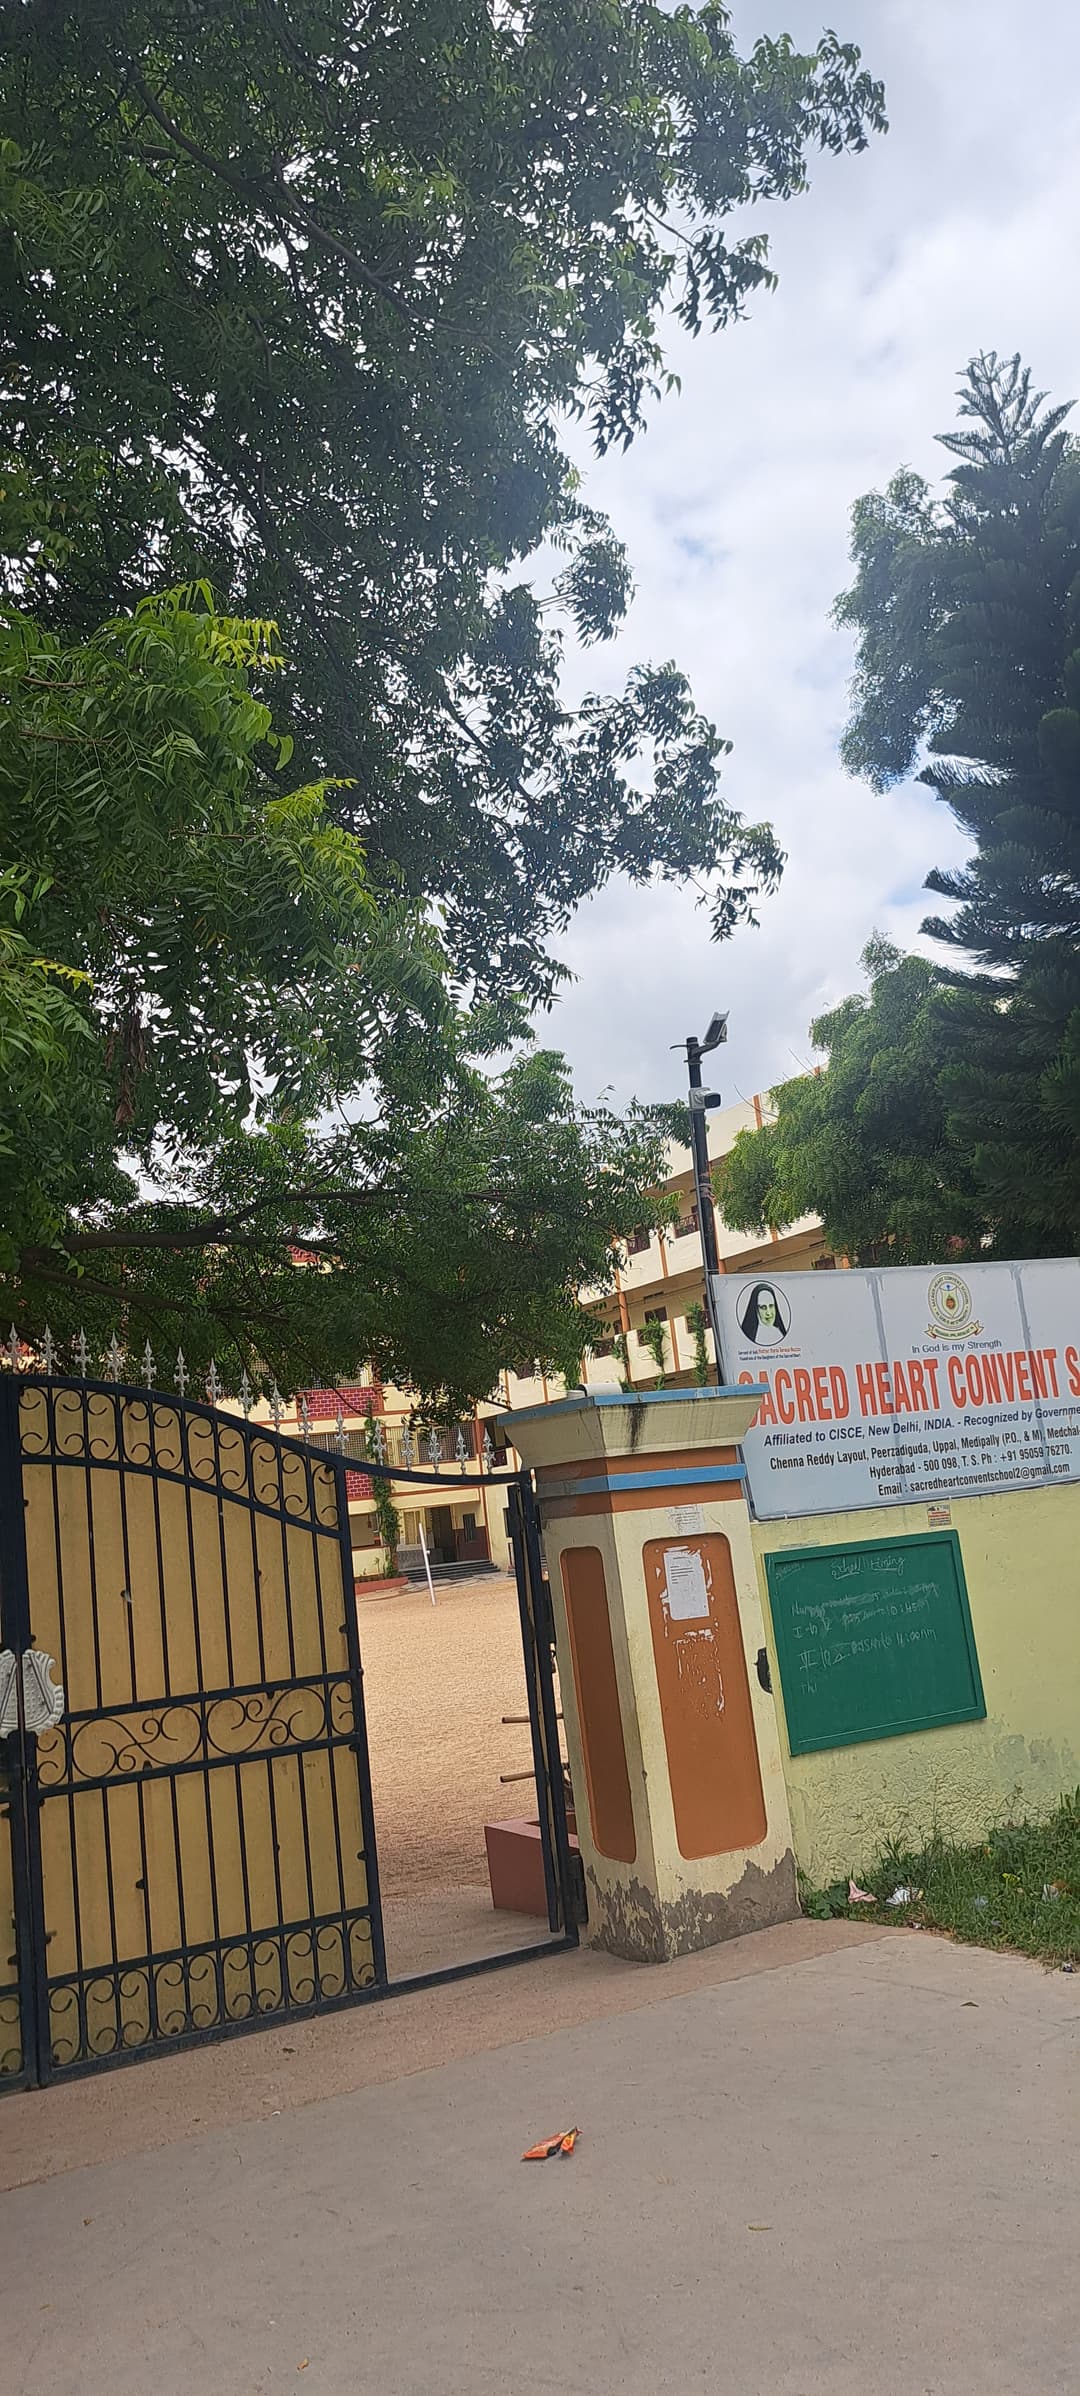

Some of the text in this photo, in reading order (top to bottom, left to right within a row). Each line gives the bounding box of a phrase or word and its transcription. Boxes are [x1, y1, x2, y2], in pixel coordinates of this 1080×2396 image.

[911, 1340, 1002, 1353] In God is my Strength
[855, 1358, 940, 1416] HEART
[948, 1349, 1059, 1408] CONVENT
[764, 1432, 812, 1447] Affiliated
[816, 1432, 826, 1442] to
[829, 1427, 865, 1440] CISCE,
[868, 1424, 890, 1436] New
[893, 1420, 921, 1434] Delhi,
[924, 1417, 955, 1430] INDIA.
[963, 1410, 1019, 1426] Recognized
[1021, 1410, 1033, 1422] by
[770, 1457, 804, 1470] Chenna
[806, 1452, 834, 1466] Reddy
[836, 1449, 869, 1464] Layout,
[870, 1442, 931, 1459] Peerzadiguda,
[932, 1439, 960, 1454] Uppal,
[961, 1434, 1000, 1449] Medipally
[1023, 1430, 1030, 1442] &
[869, 1462, 916, 1480] Hyderabad
[923, 1459, 939, 1472] 500
[941, 1456, 961, 1470] 098,
[961, 1455, 969, 1466] T.
[970, 1454, 980, 1466] S.
[981, 1452, 992, 1464] Ph
[1000, 1450, 1017, 1462] +91
[1019, 1447, 1044, 1460] 95059
[1045, 1443, 1073, 1457] 76270.
[878, 1482, 903, 1496] Email
[910, 1463, 1070, 1492] sacredheartconventschool2@gmail.com
